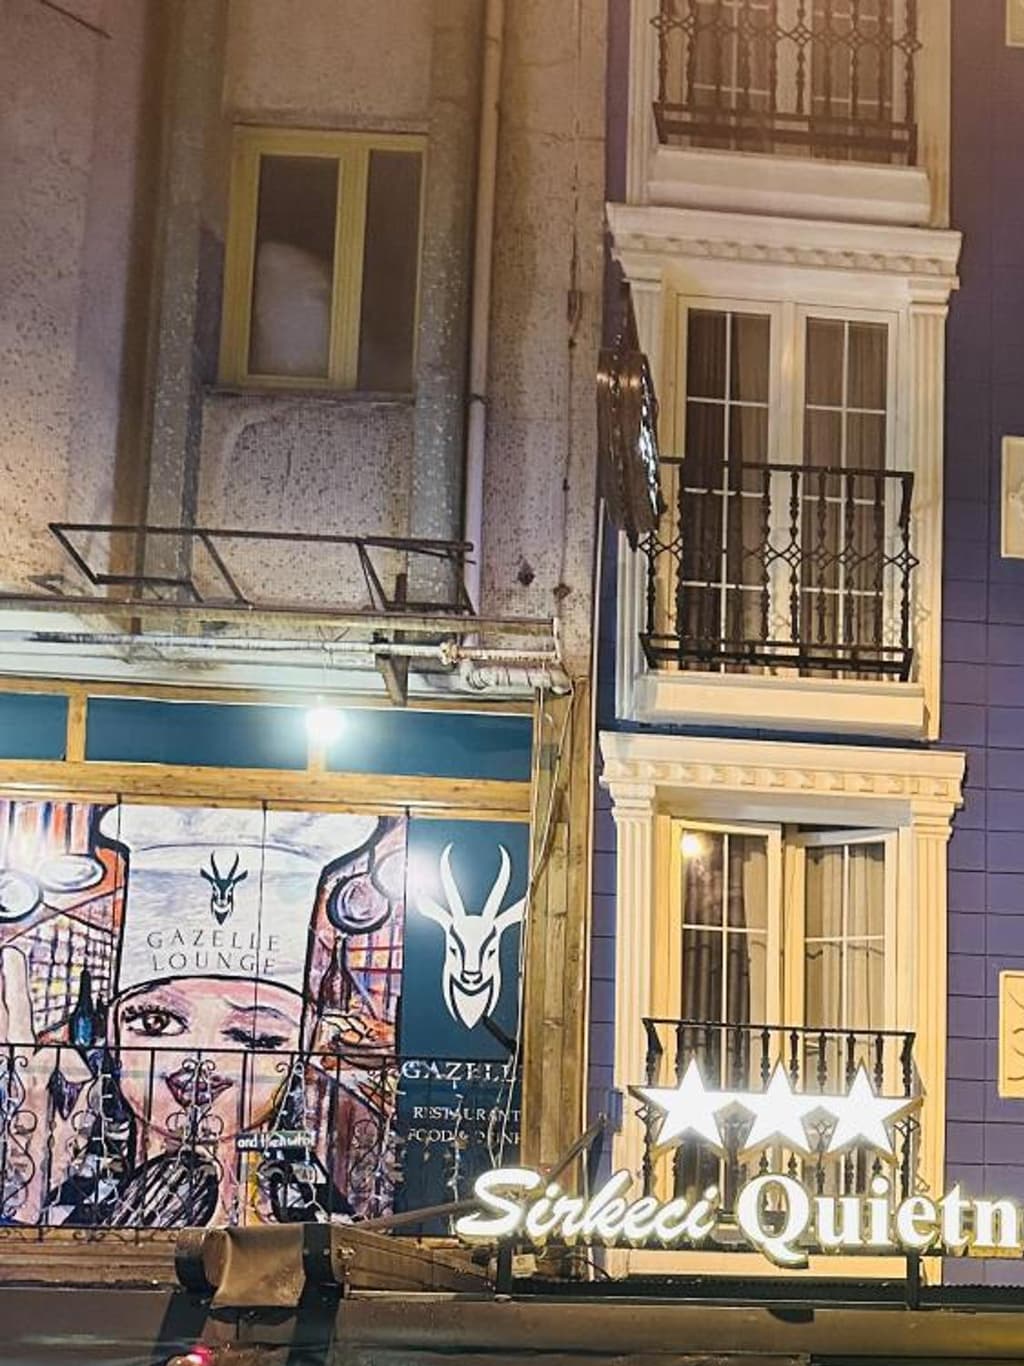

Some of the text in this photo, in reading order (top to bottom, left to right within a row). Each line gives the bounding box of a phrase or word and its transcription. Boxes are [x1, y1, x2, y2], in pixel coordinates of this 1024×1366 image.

[147, 928, 280, 951] GAZELLE
[153, 952, 276, 975] LOUNGE
[402, 1060, 522, 1082] GAZELL
[457, 1168, 719, 1240] Sirkeci
